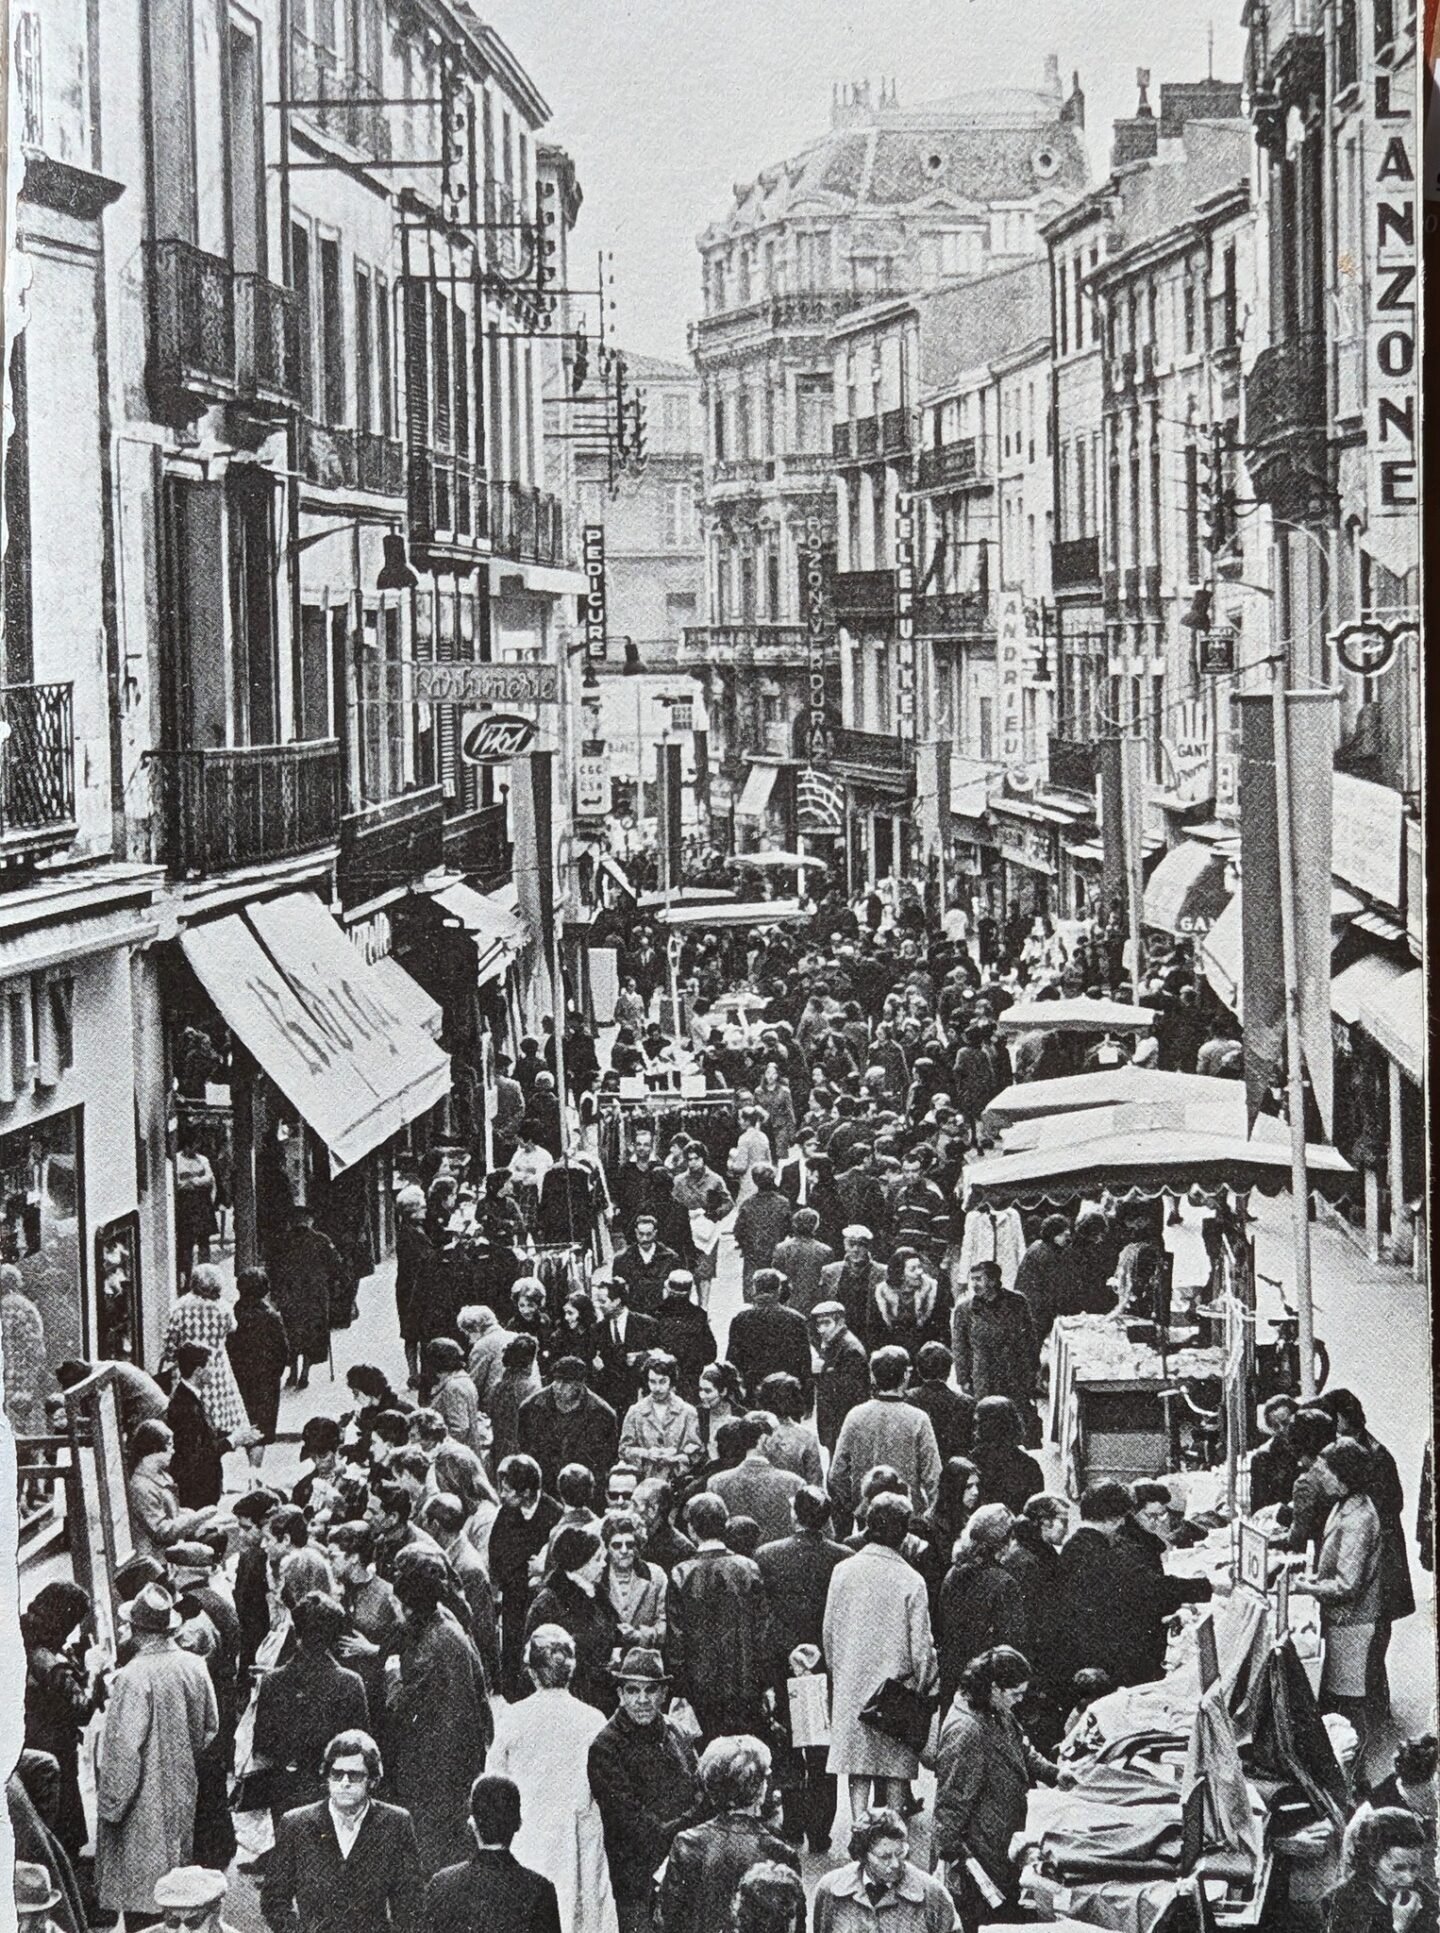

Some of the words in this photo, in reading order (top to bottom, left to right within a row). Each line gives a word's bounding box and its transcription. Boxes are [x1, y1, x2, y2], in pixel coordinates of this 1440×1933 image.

[1374, 75, 1417, 507] LANZONE
[586, 529, 604, 656] PEDICURE
[898, 491, 915, 739] TELEFUNKEN
[1003, 601, 1019, 754] ANDRIEU
[1178, 744, 1209, 757] GANT
